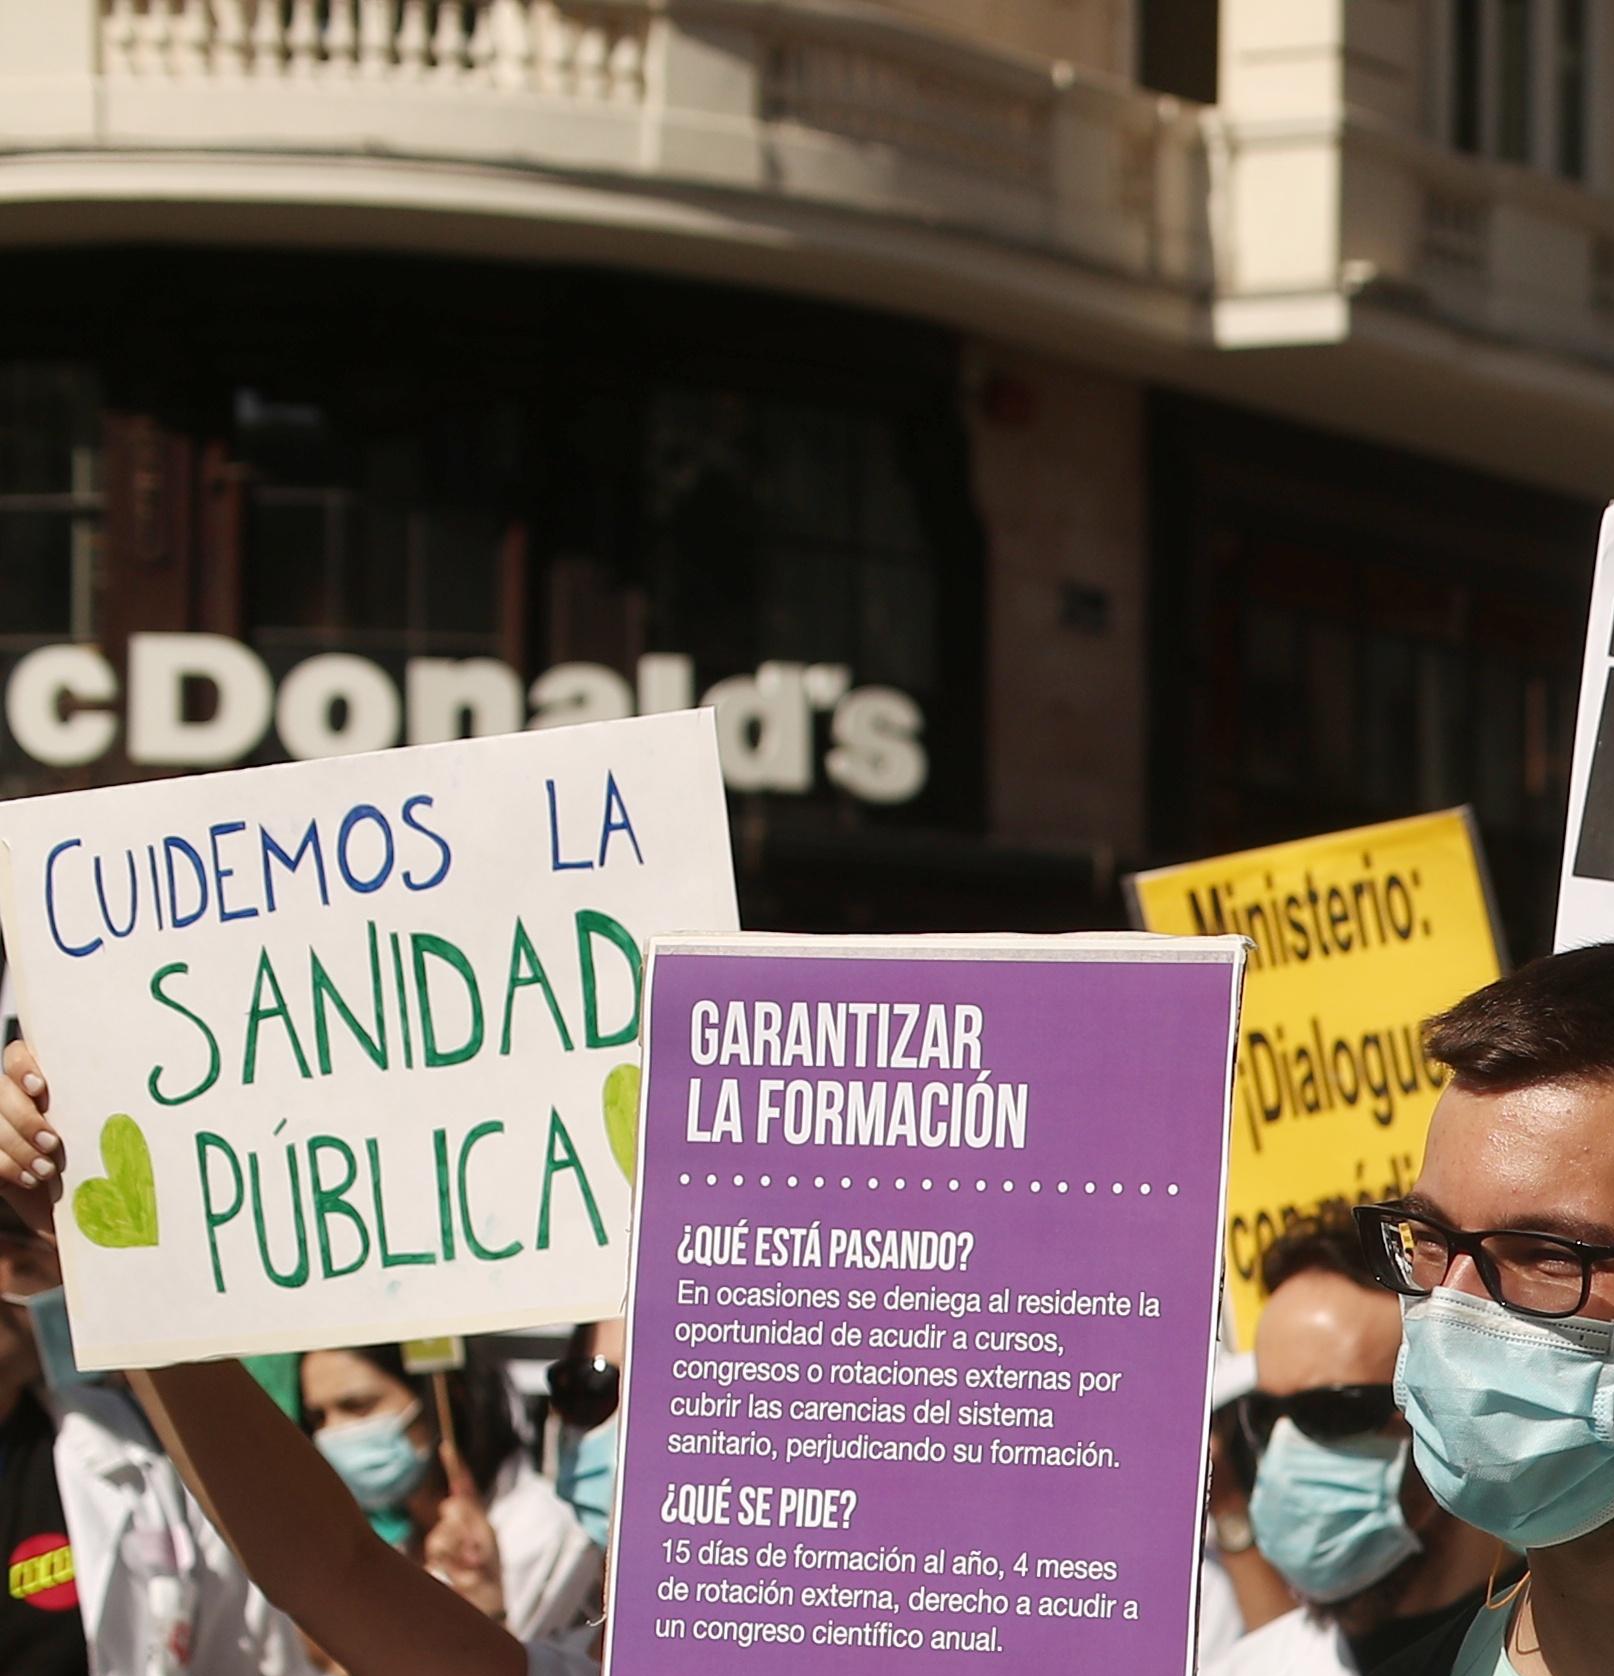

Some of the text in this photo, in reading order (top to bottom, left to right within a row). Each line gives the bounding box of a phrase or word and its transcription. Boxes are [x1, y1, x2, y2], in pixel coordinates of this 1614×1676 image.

[45, 769, 645, 958] CUIDEMOS LA
[147, 908, 643, 1106] SANIDAD
[691, 1000, 983, 1070] GARANTIZAR
[686, 1067, 1028, 1149] LA FORMACIÓN
[195, 1104, 610, 1293] PÚBLICA
[677, 1219, 974, 1271] ¿QUÉ ESTÁ PASANDO?
[677, 1279, 1160, 1318] En ocasiones se deniega al residente la
[675, 1319, 1064, 1357] oportunidad de acudir a cursos,
[672, 1359, 1122, 1395] congresos o rotaciones externas por
[670, 1392, 1054, 1428] cubrir las carencias del sistema
[667, 1429, 1120, 1468] sanitario, perjudicando su formación.
[661, 1479, 857, 1529] ¿QUÉ SE PIDE?
[662, 1538, 1117, 1581] 15 días de formación al año, 4 meses
[657, 1576, 1139, 1620] de rotación externa, derecho a acudir a
[655, 1618, 1003, 1652] un congreso científico anual.
